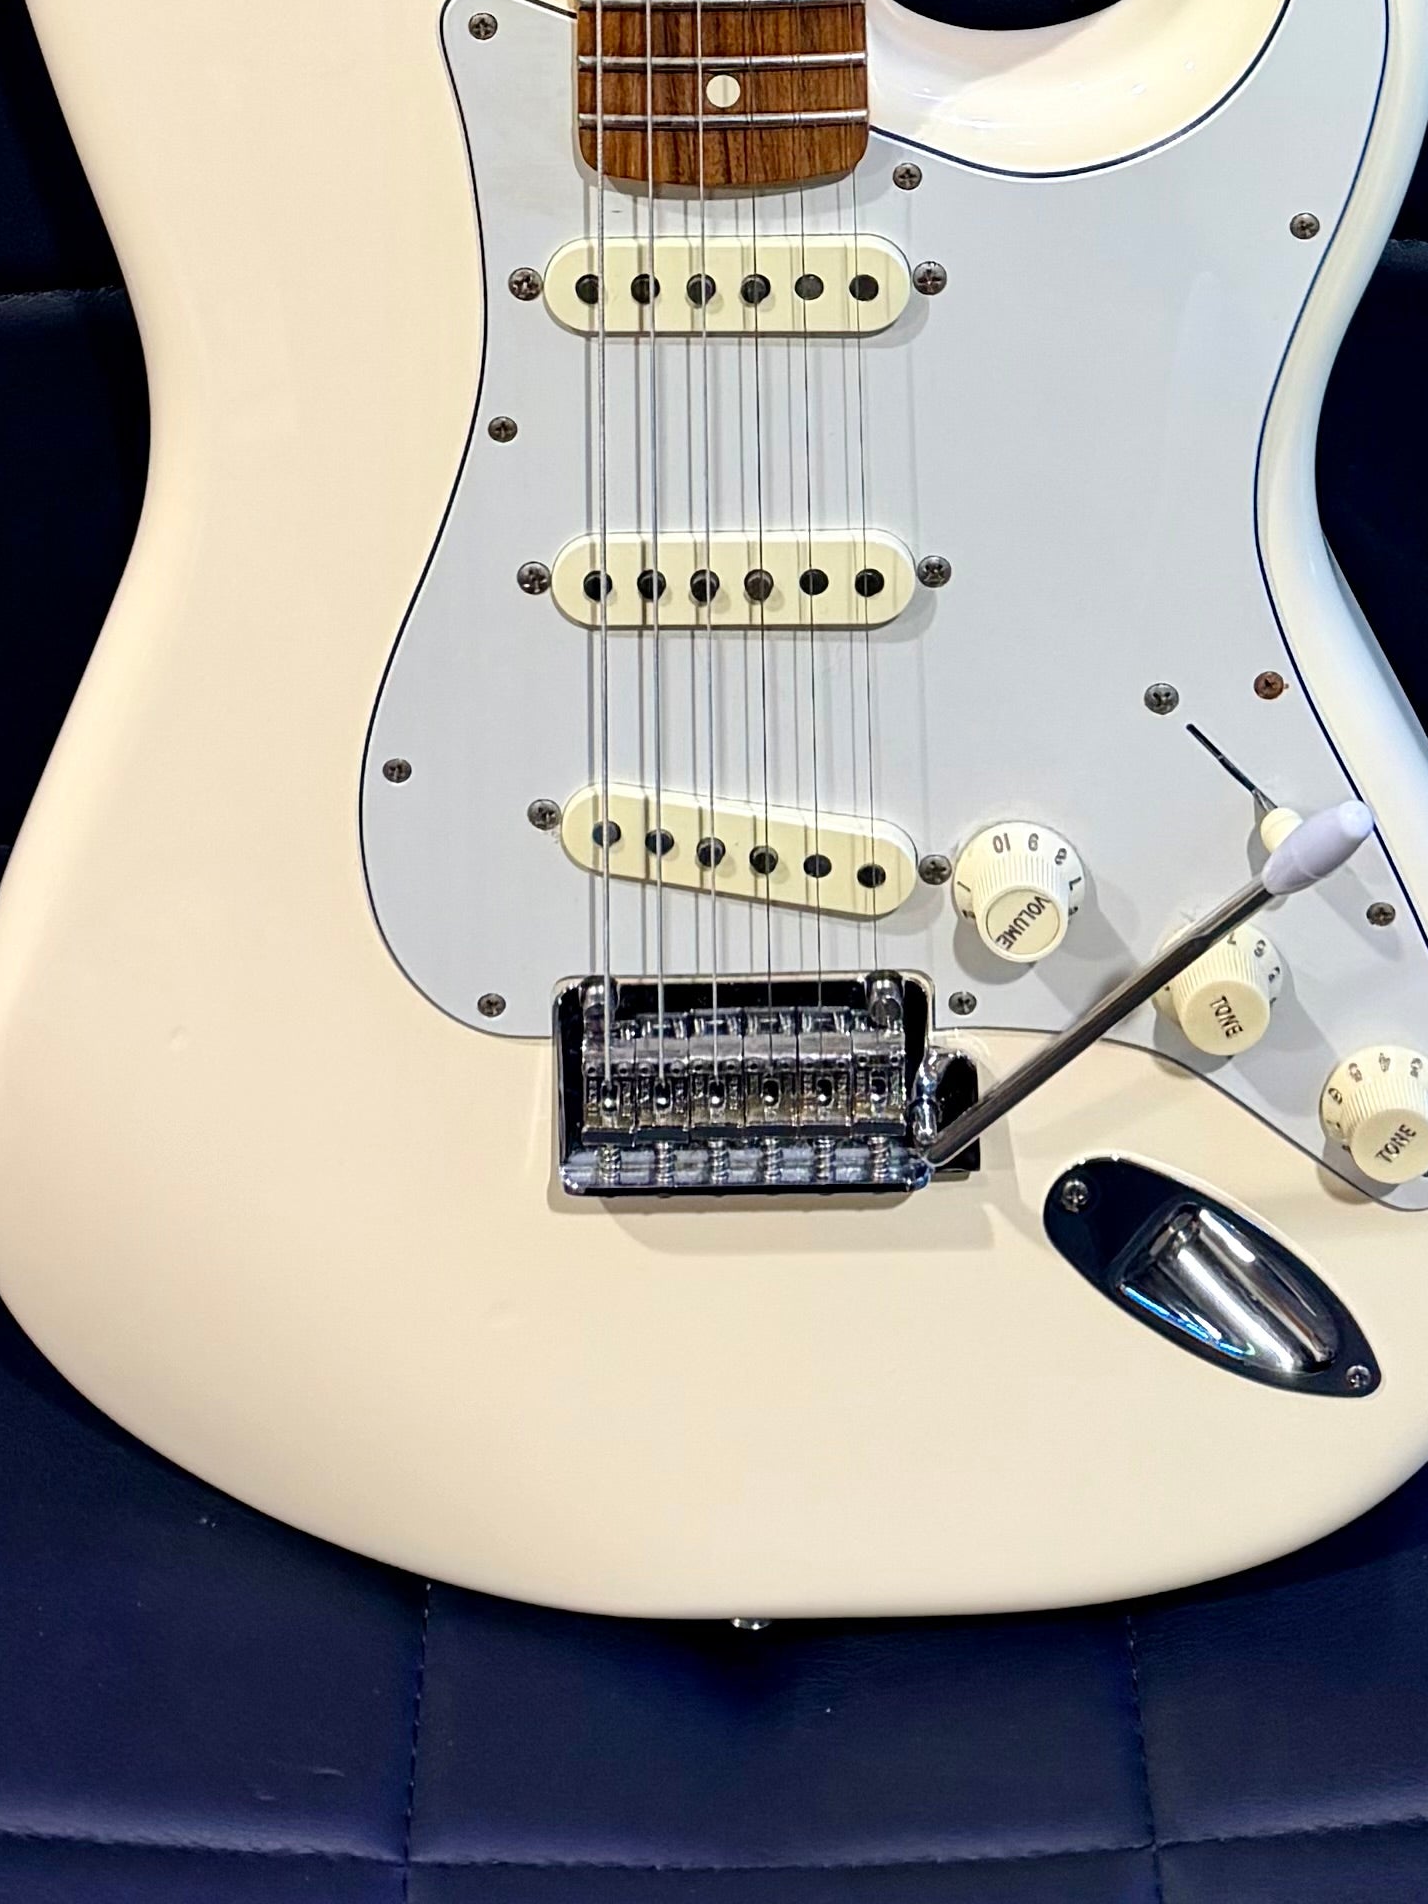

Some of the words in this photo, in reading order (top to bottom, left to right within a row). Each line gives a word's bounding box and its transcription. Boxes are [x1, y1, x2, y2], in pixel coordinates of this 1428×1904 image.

[995, 895, 1053, 951] VOLUME
[1208, 994, 1244, 1039] TONE
[1374, 1123, 1417, 1164] TONE
